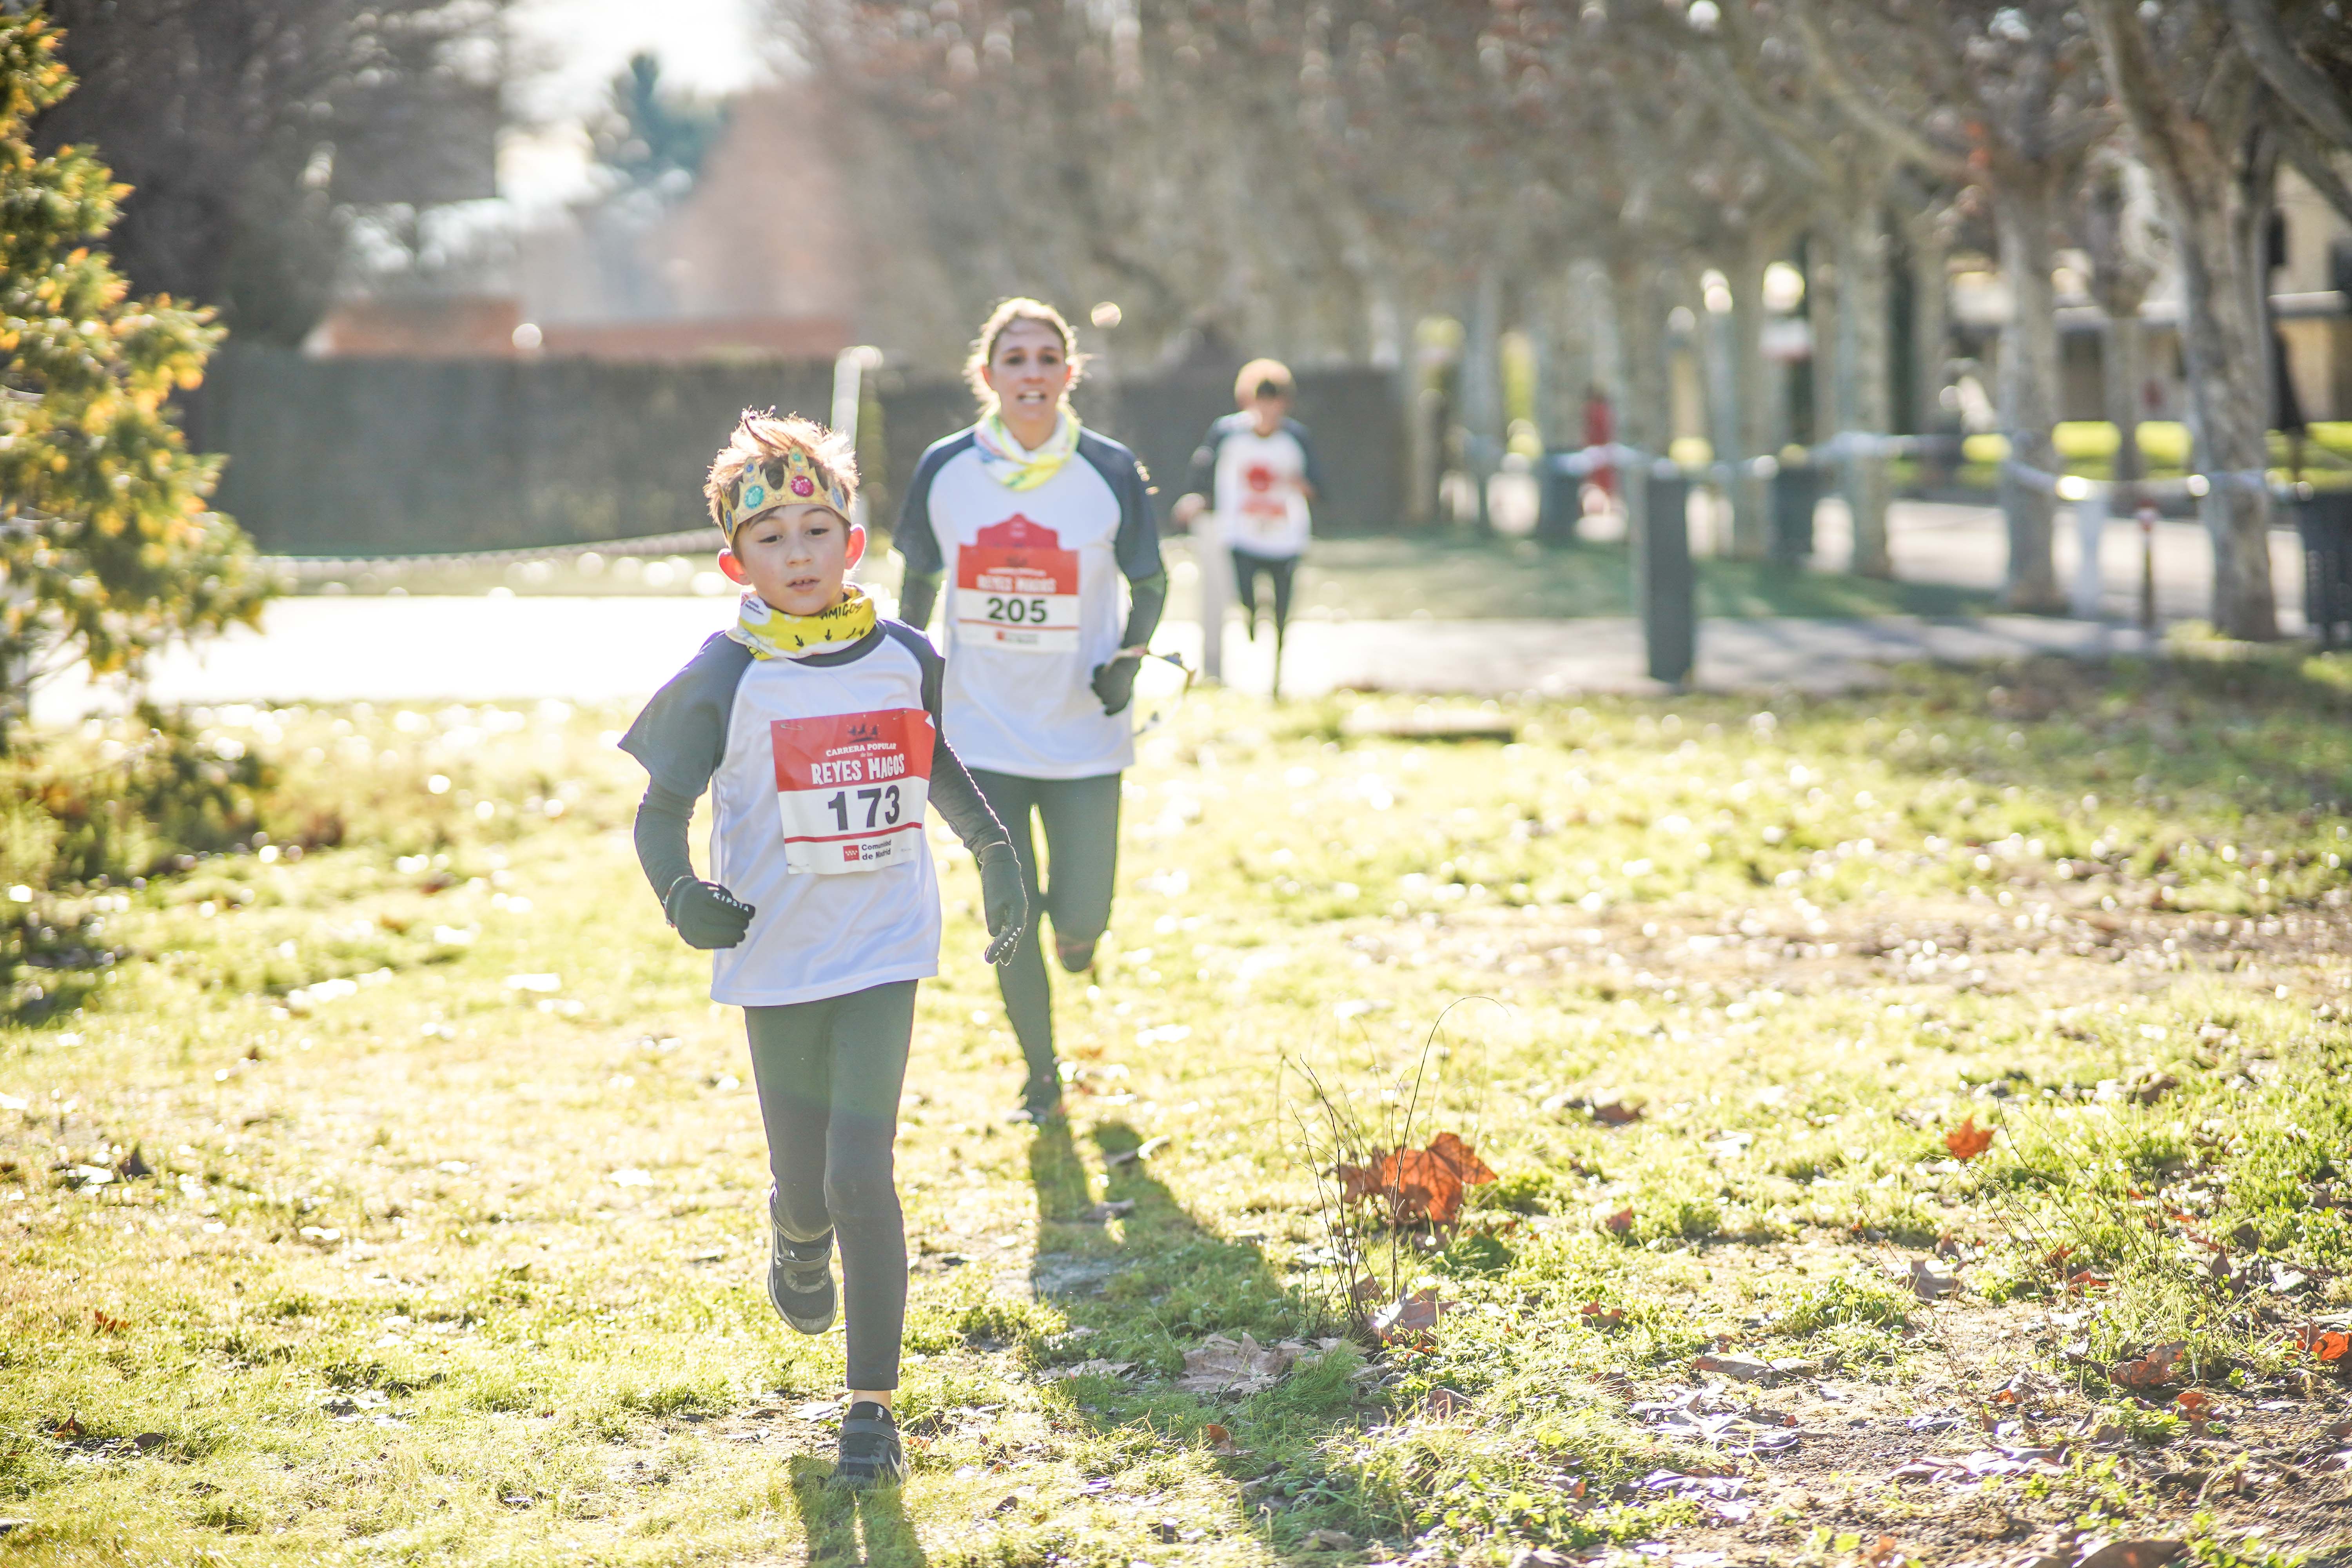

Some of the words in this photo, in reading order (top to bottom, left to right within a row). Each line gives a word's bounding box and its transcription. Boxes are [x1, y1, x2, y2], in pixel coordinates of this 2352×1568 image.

[820, 603, 862, 620] AMIGOS
[987, 597, 1047, 623] 205
[826, 744, 866, 757] CARRERA
[867, 743, 897, 751] POPULAR
[811, 760, 862, 784] REYES
[867, 753, 905, 780] MAGOS
[828, 785, 900, 831] 173
[862, 839, 891, 850] Comunidad
[876, 848, 891, 858] Madrid
